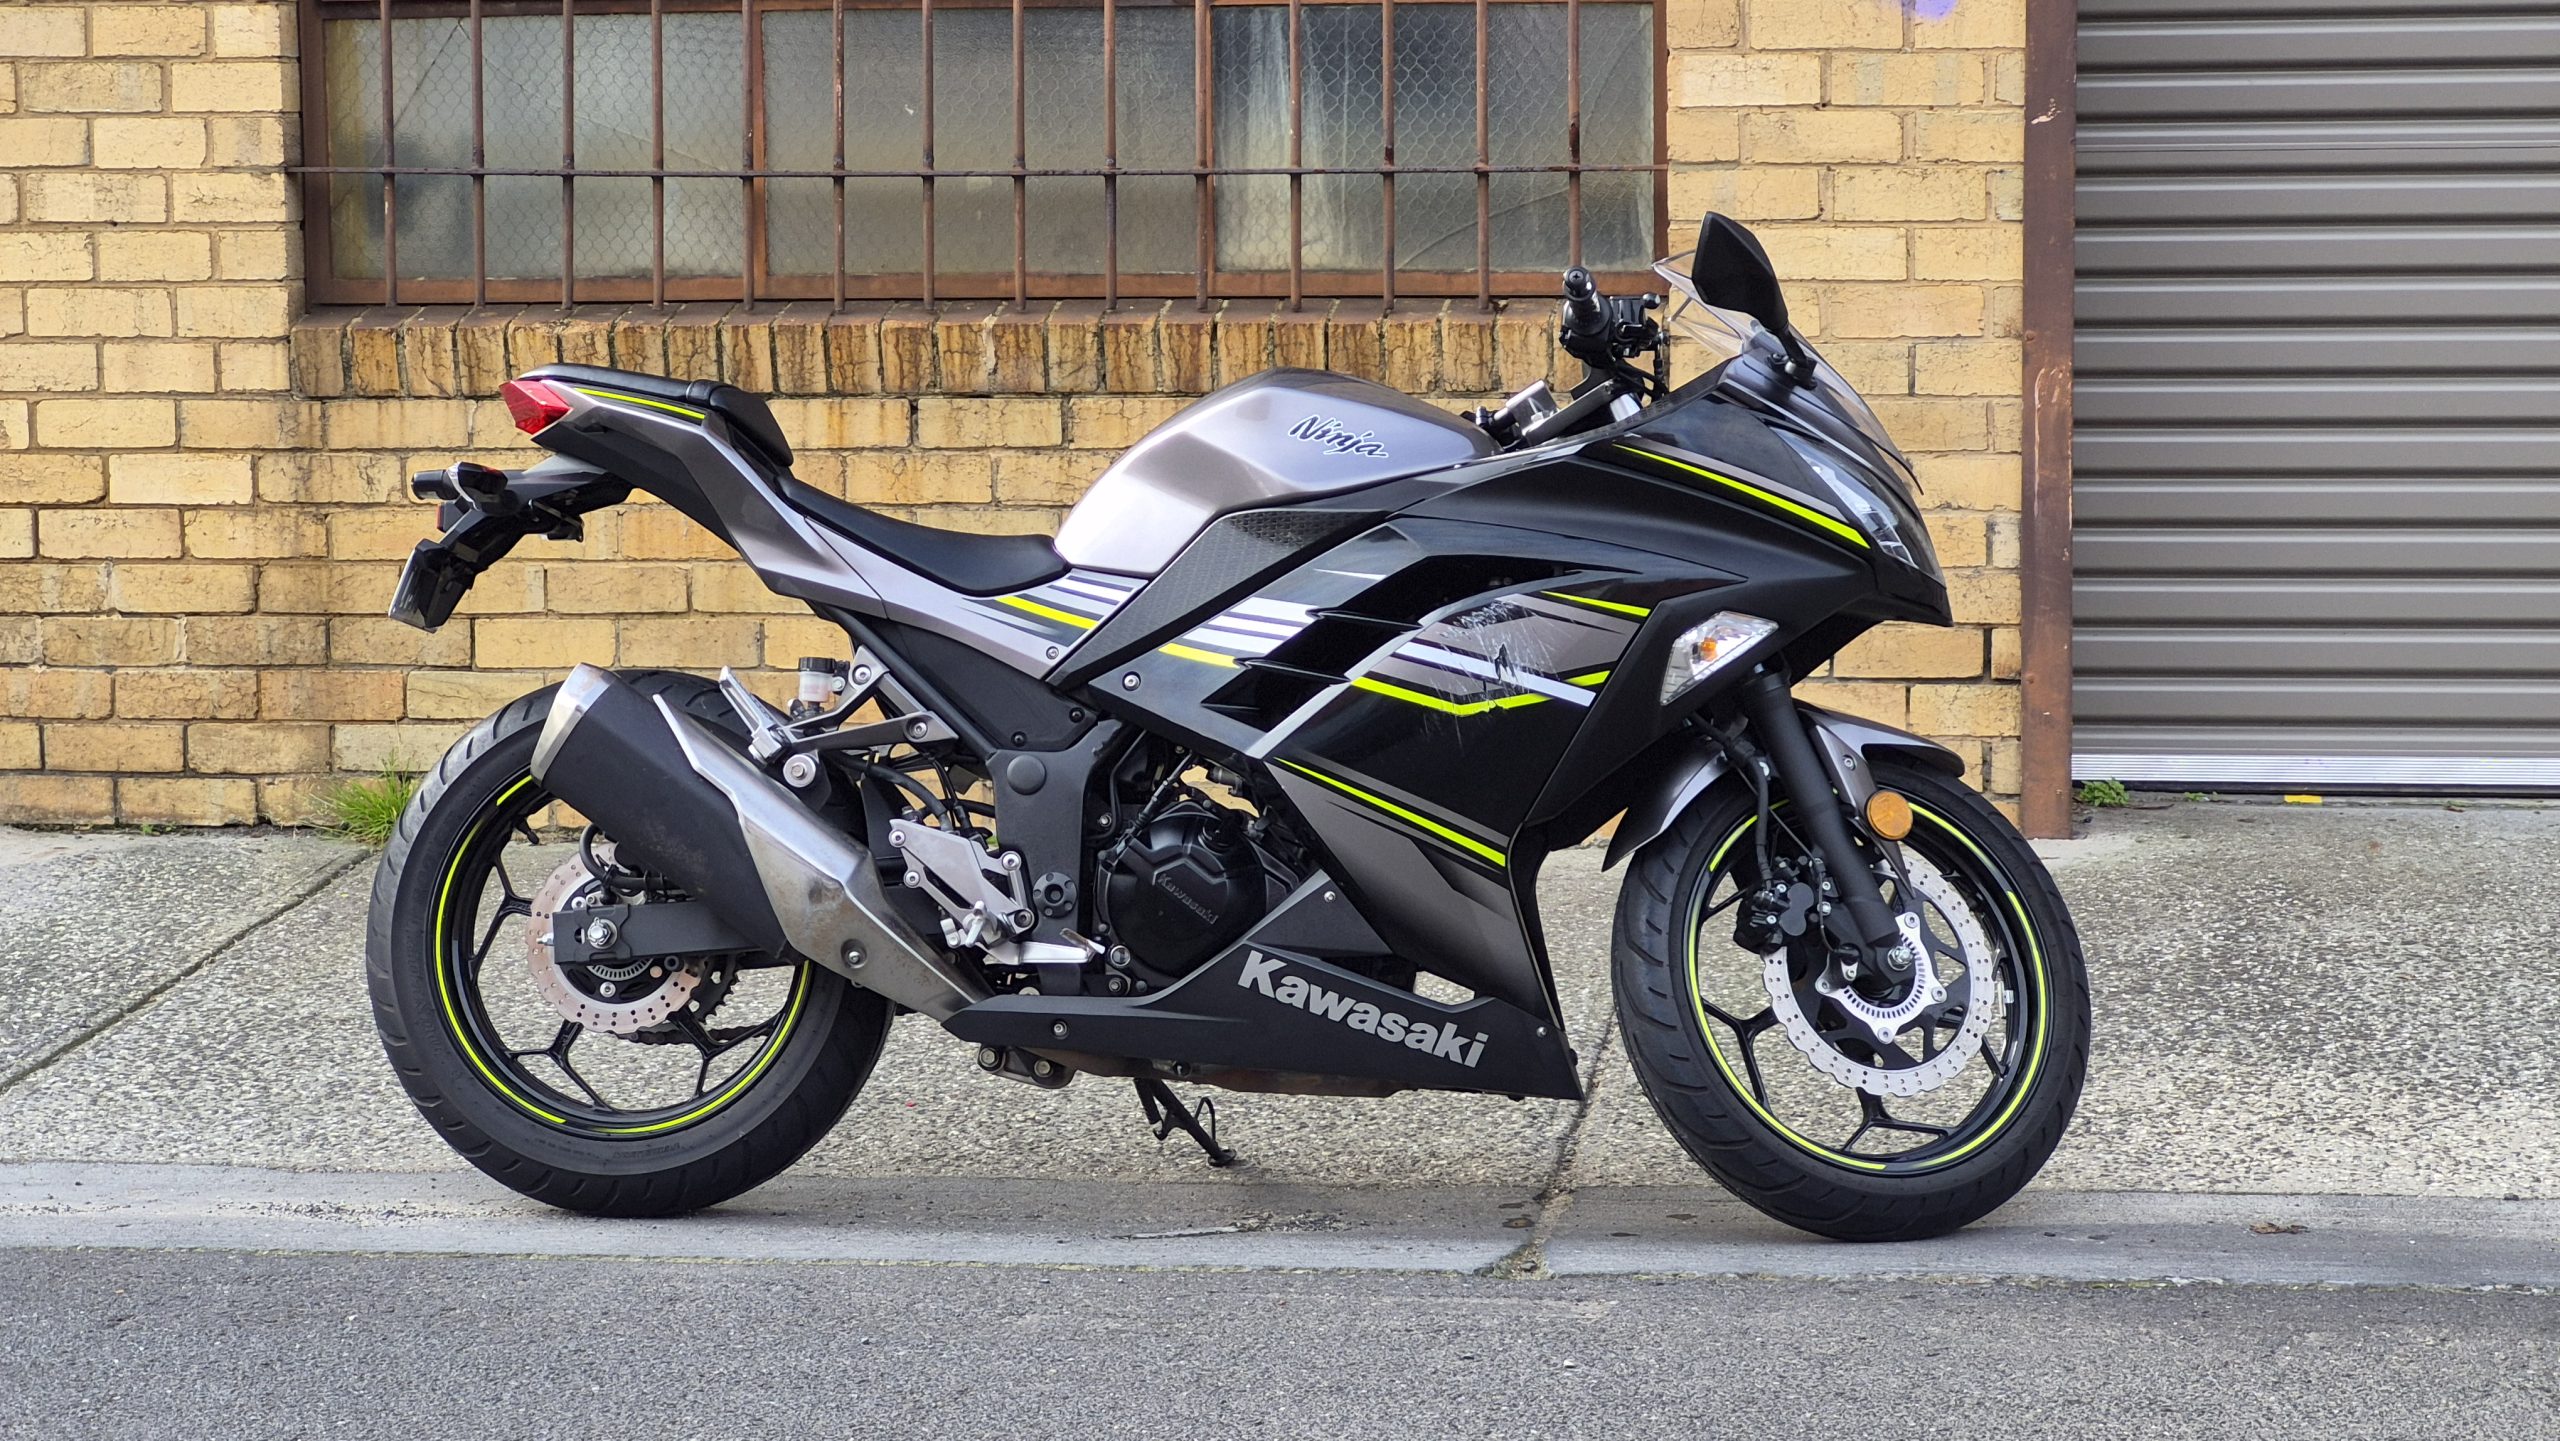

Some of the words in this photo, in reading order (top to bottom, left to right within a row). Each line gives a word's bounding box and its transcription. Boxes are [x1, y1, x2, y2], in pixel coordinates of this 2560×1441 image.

[1288, 415, 1388, 457] Ninja
[1157, 873, 1219, 925] Kawasaki
[1237, 949, 1490, 1069] Kawasaki
